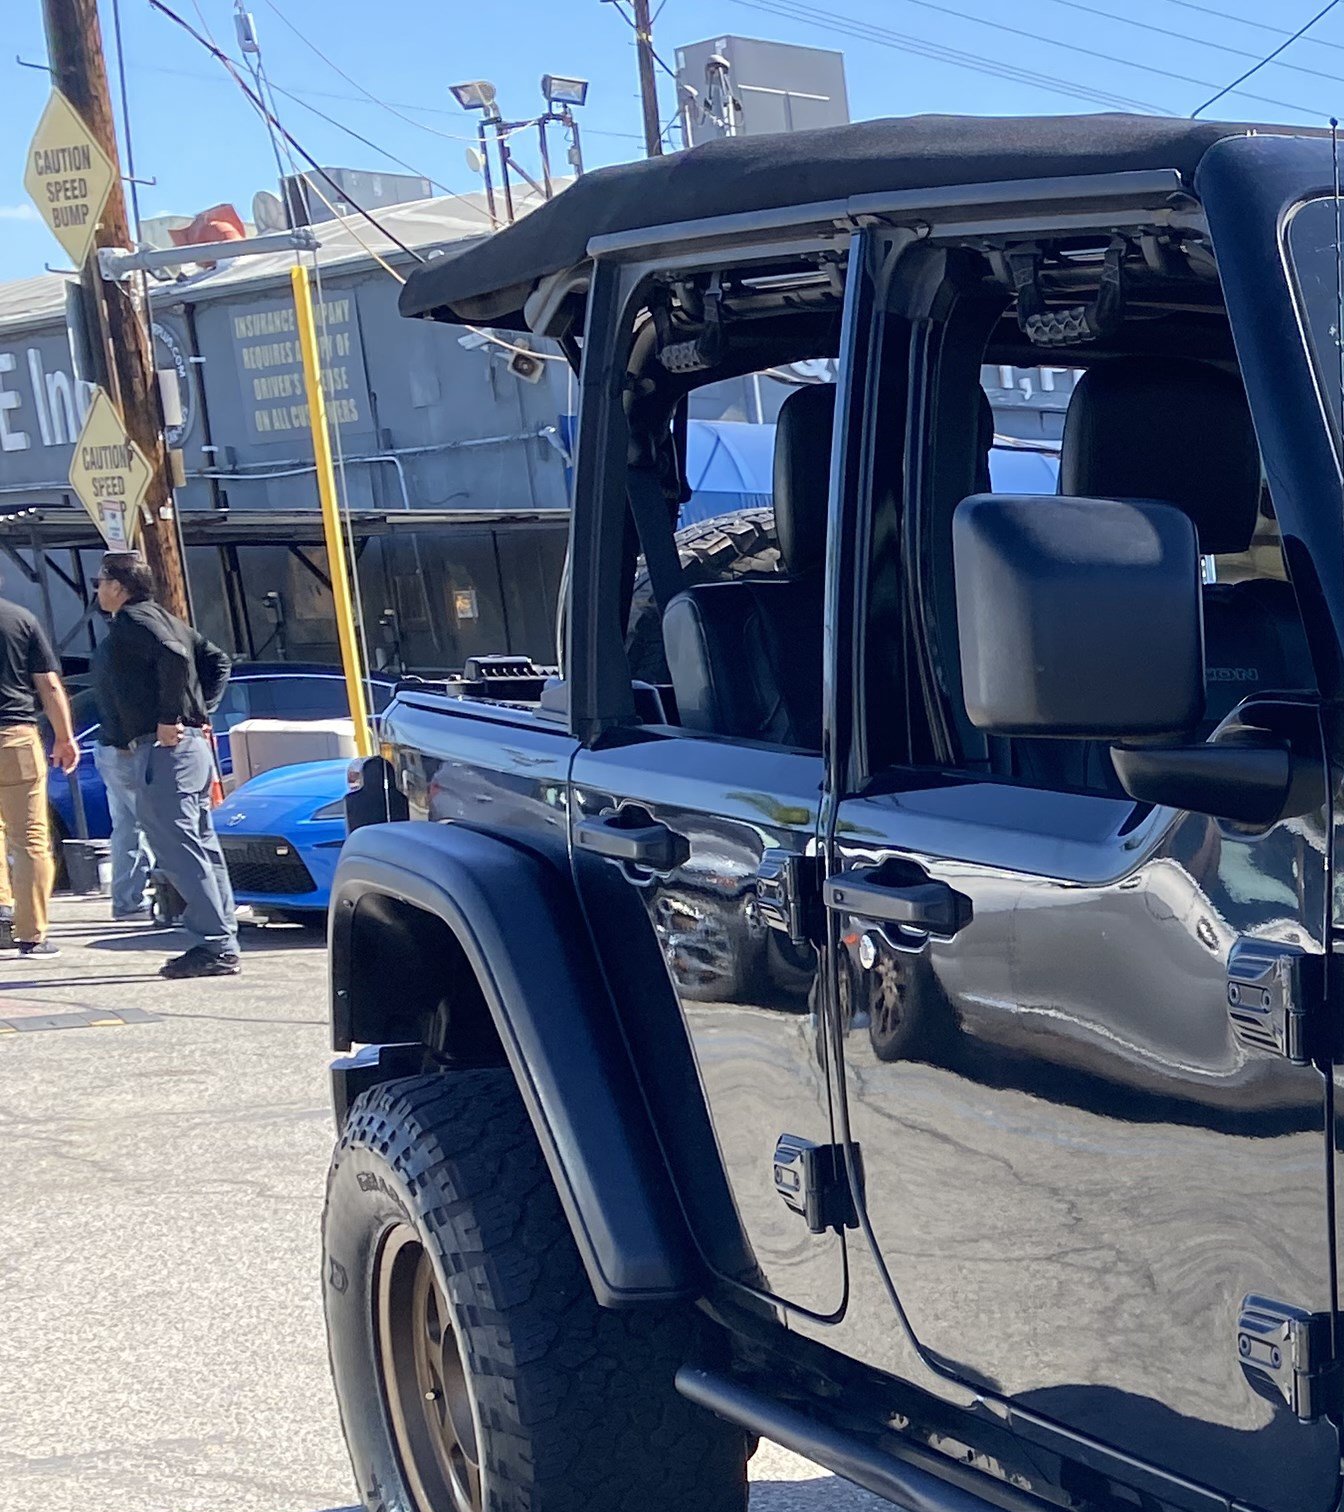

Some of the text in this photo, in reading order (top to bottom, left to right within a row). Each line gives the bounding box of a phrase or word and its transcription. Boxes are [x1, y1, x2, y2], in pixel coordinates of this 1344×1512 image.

[34, 144, 91, 176] CAUTION
[46, 178, 87, 202] SPEED
[52, 204, 89, 228] BUMP
[234, 308, 295, 339] INSURANCE
[242, 341, 294, 369] REQUIRES
[335, 333, 350, 357] OF
[253, 373, 301, 400] DRIVER'S
[255, 398, 359, 432] ON ALL CUMERS
[82, 444, 128, 471] CAUTION
[92, 476, 125, 497] SPEED
[97, 500, 127, 522] BP
